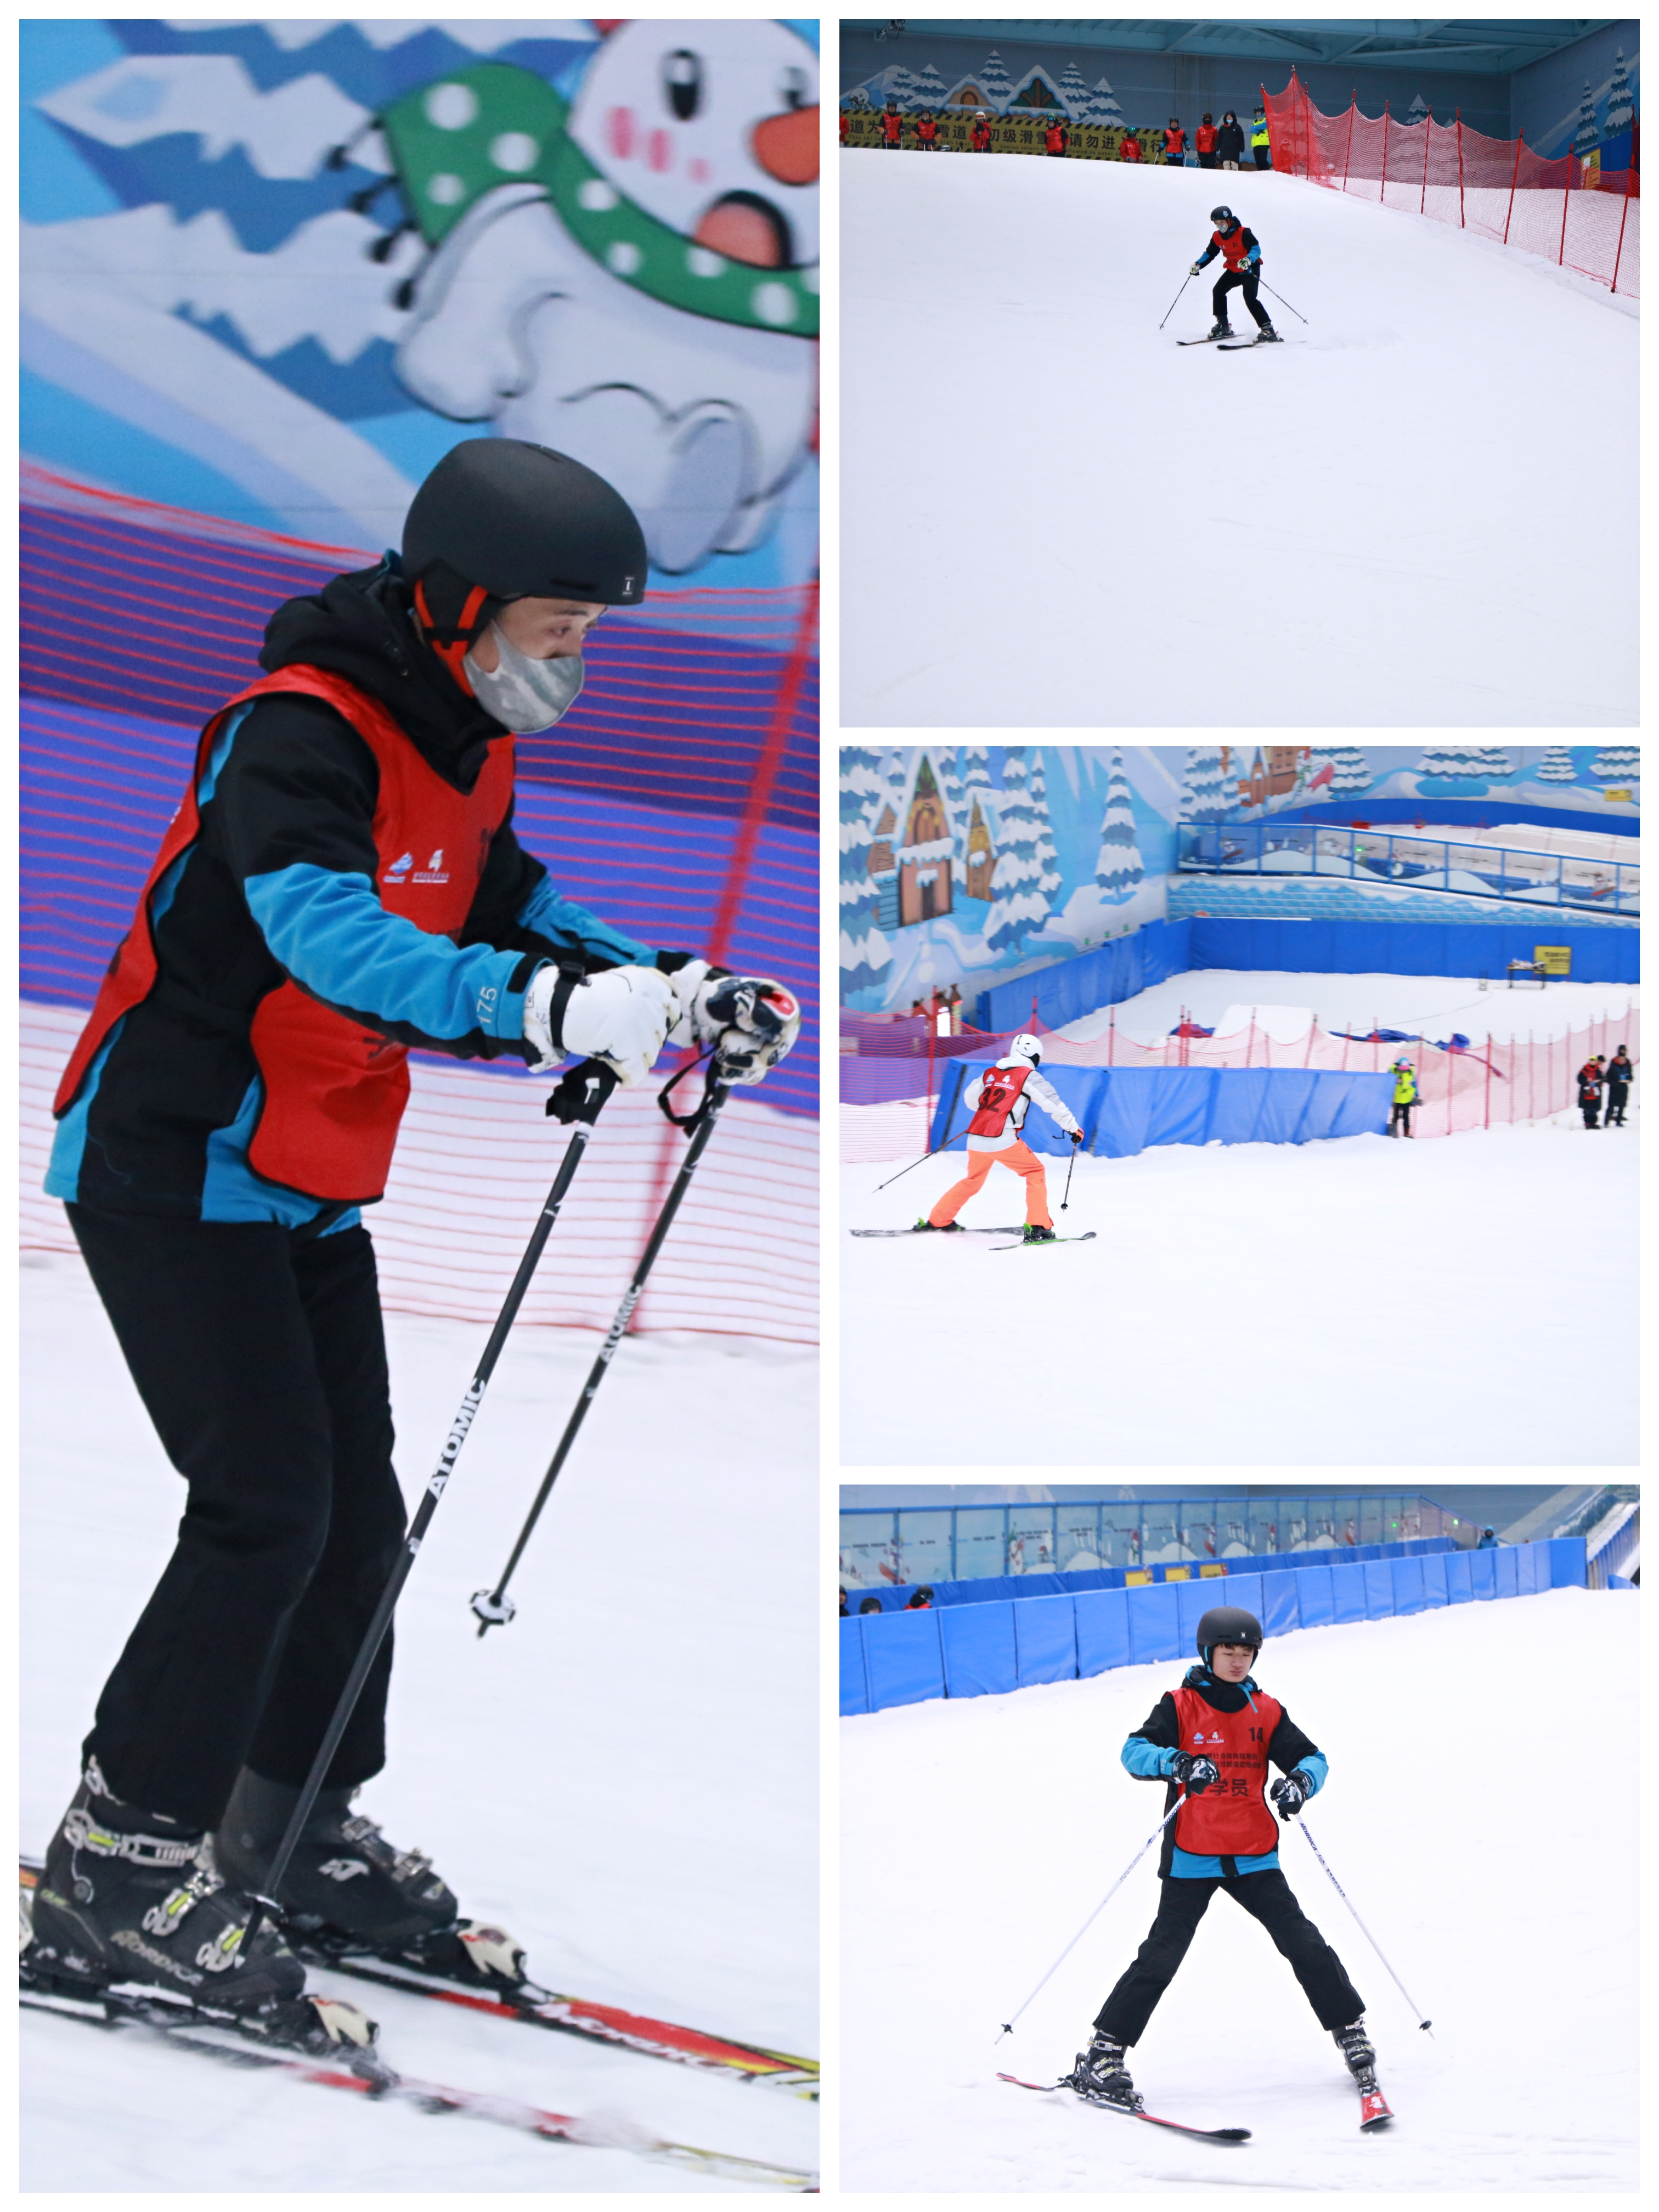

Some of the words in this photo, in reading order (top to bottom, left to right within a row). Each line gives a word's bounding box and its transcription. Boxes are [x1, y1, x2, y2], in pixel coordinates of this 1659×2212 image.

[476, 985, 497, 1024] 175
[978, 1087, 1006, 1113] 32
[601, 1283, 642, 1363] ATOMIC
[427, 1376, 487, 1500] ATOMIC
[1249, 1727, 1263, 1742] 14
[1209, 1778, 1248, 1797] 学员
[1299, 1822, 1318, 1851] NORDICA
